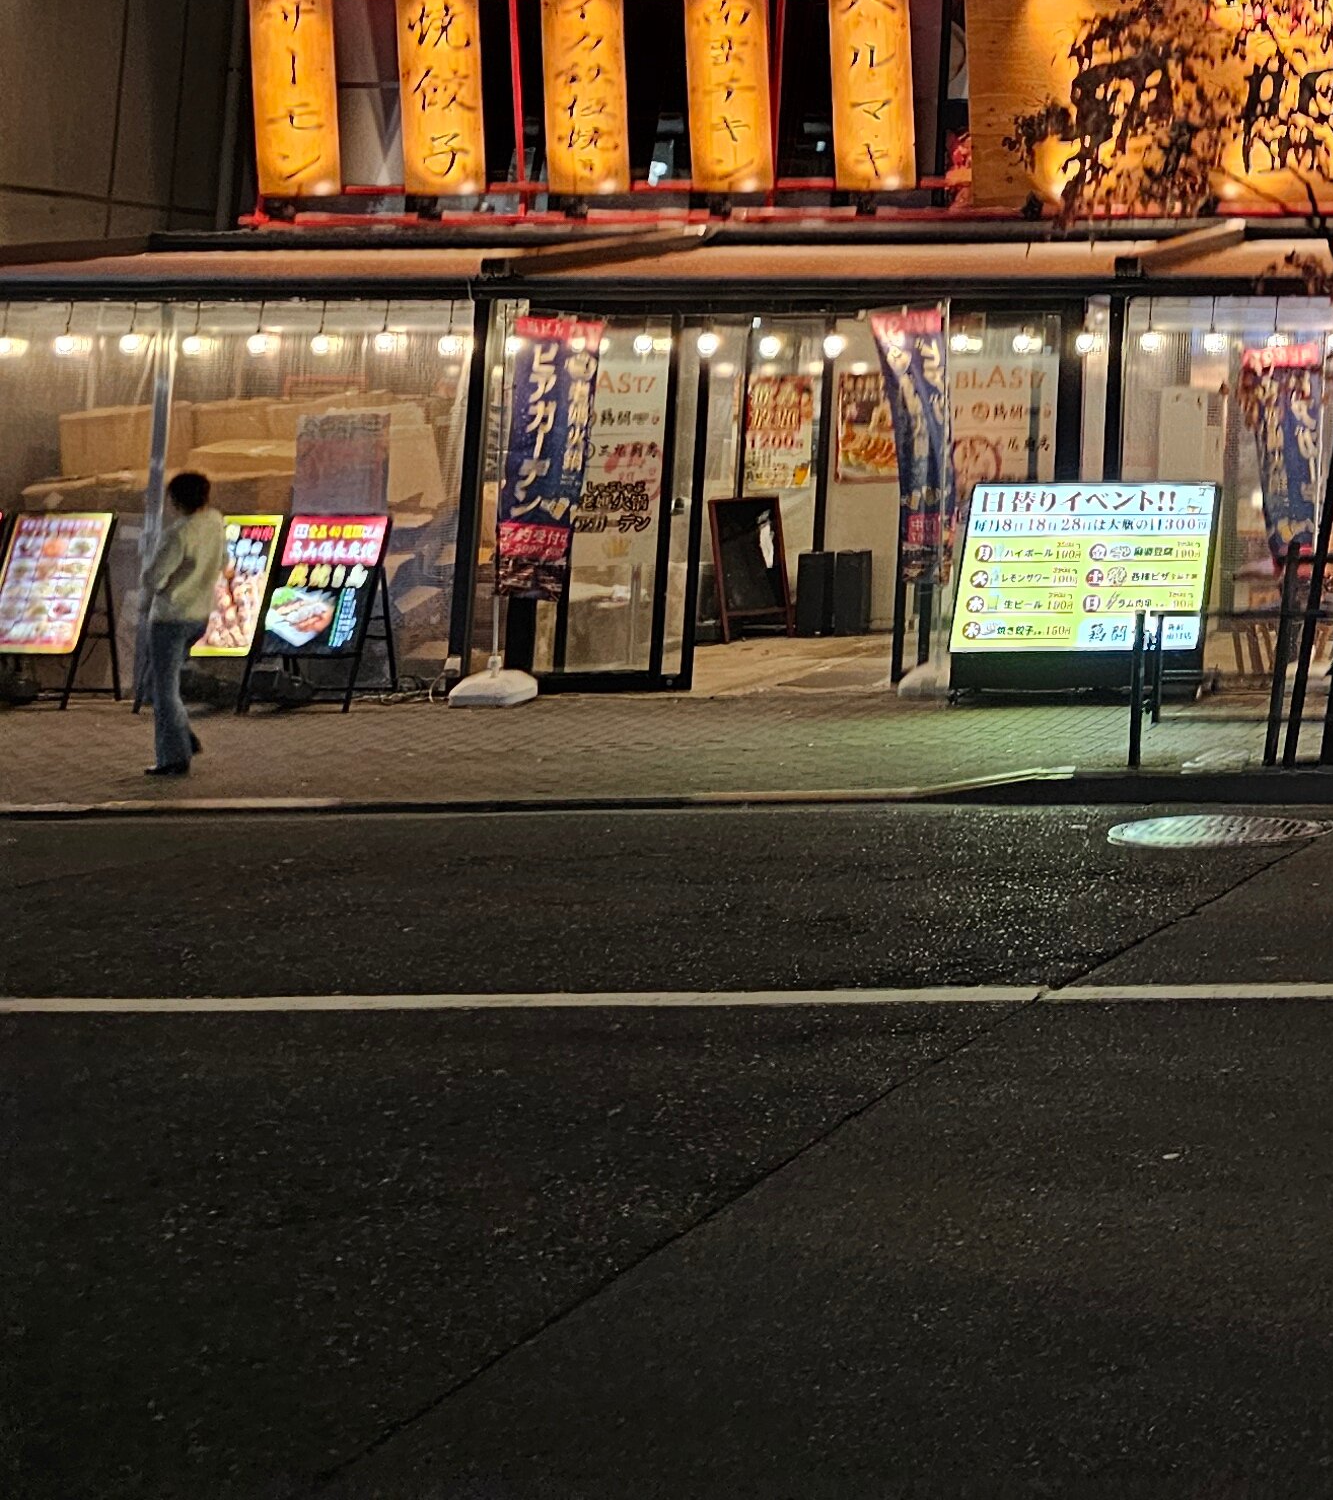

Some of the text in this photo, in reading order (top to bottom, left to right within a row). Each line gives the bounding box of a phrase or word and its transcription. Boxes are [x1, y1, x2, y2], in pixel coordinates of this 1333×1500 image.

[266, 0, 325, 180] サーモン
[408, 3, 476, 177] 焼餃子
[510, 343, 560, 518] ビアガーデン
[1001, 574, 1050, 583] レモンサワー
[1004, 549, 1053, 559] ハイボール
[1004, 600, 1043, 610] 生ビール
